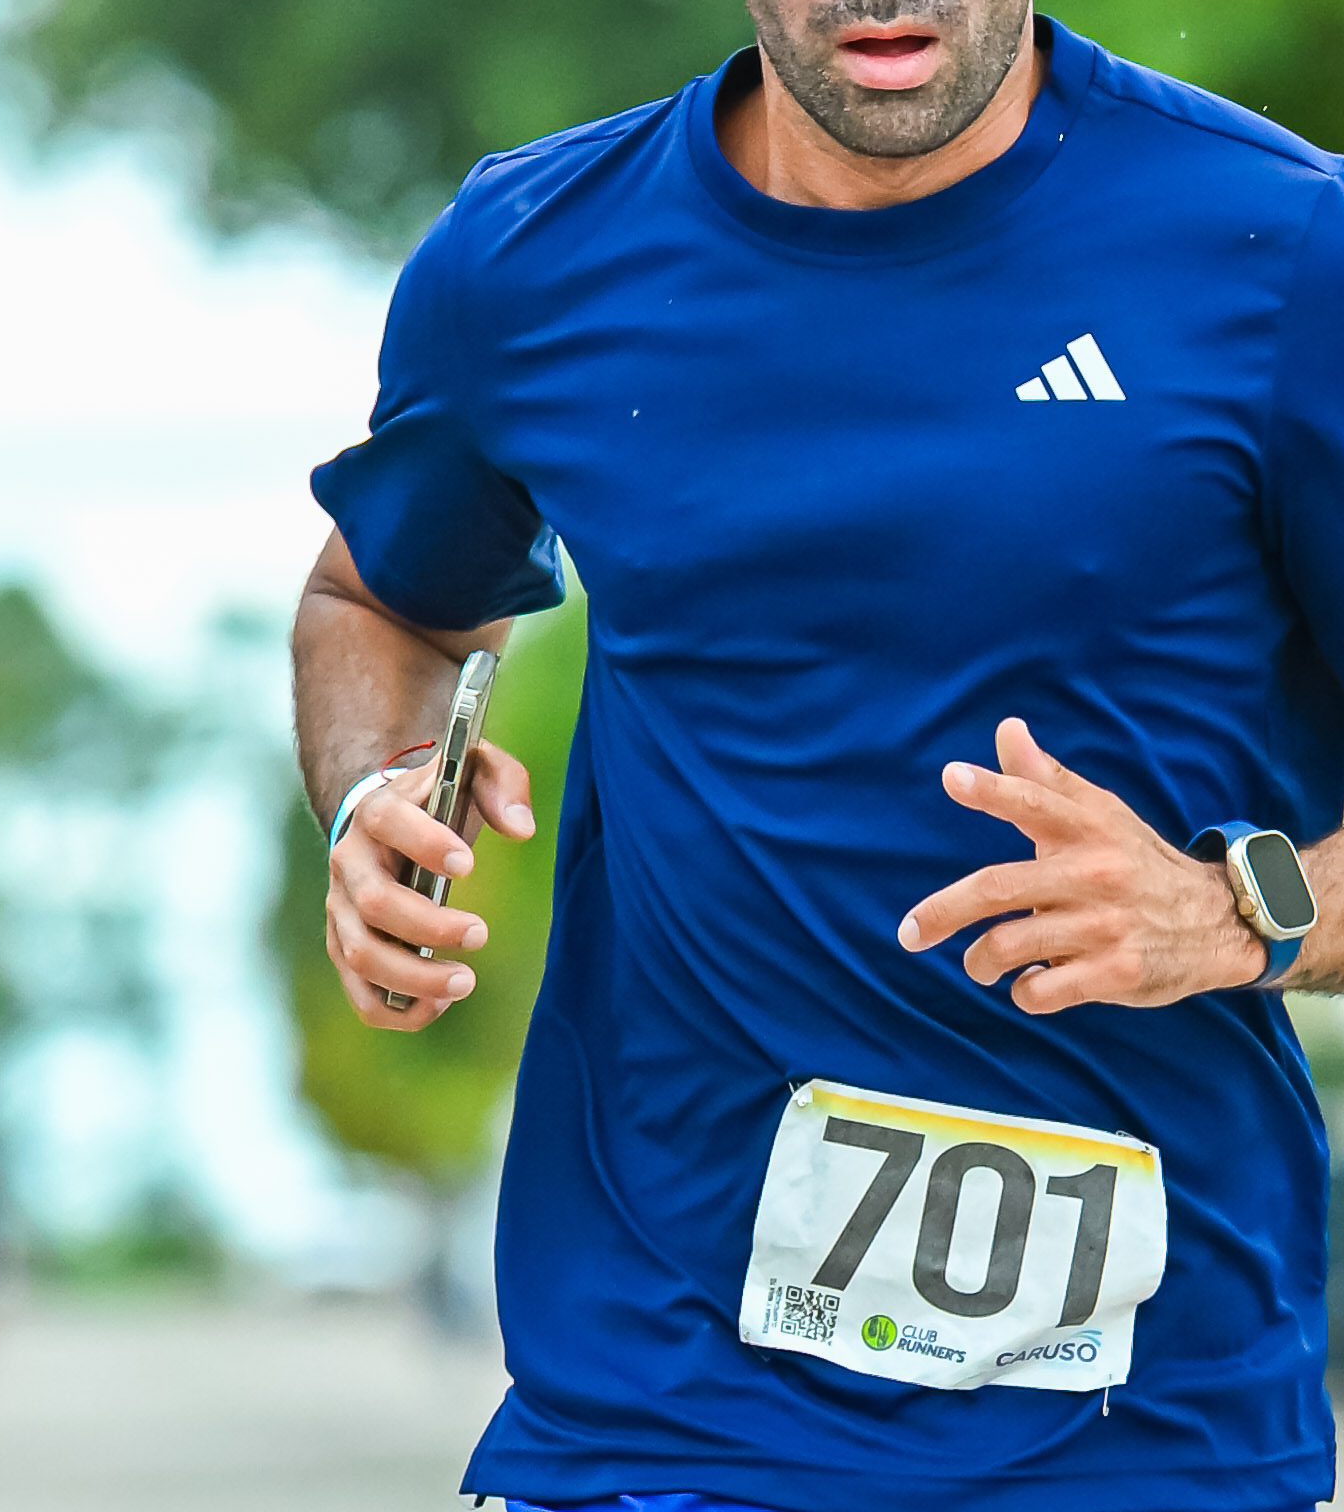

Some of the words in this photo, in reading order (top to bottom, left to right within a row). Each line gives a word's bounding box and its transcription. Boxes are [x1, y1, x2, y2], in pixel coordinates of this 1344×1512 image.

[811, 1116, 1118, 1328] 701
[902, 1325, 938, 1343] CLUB
[897, 1338, 967, 1363] RUNNER'S
[996, 1343, 1097, 1367] CARUSO
